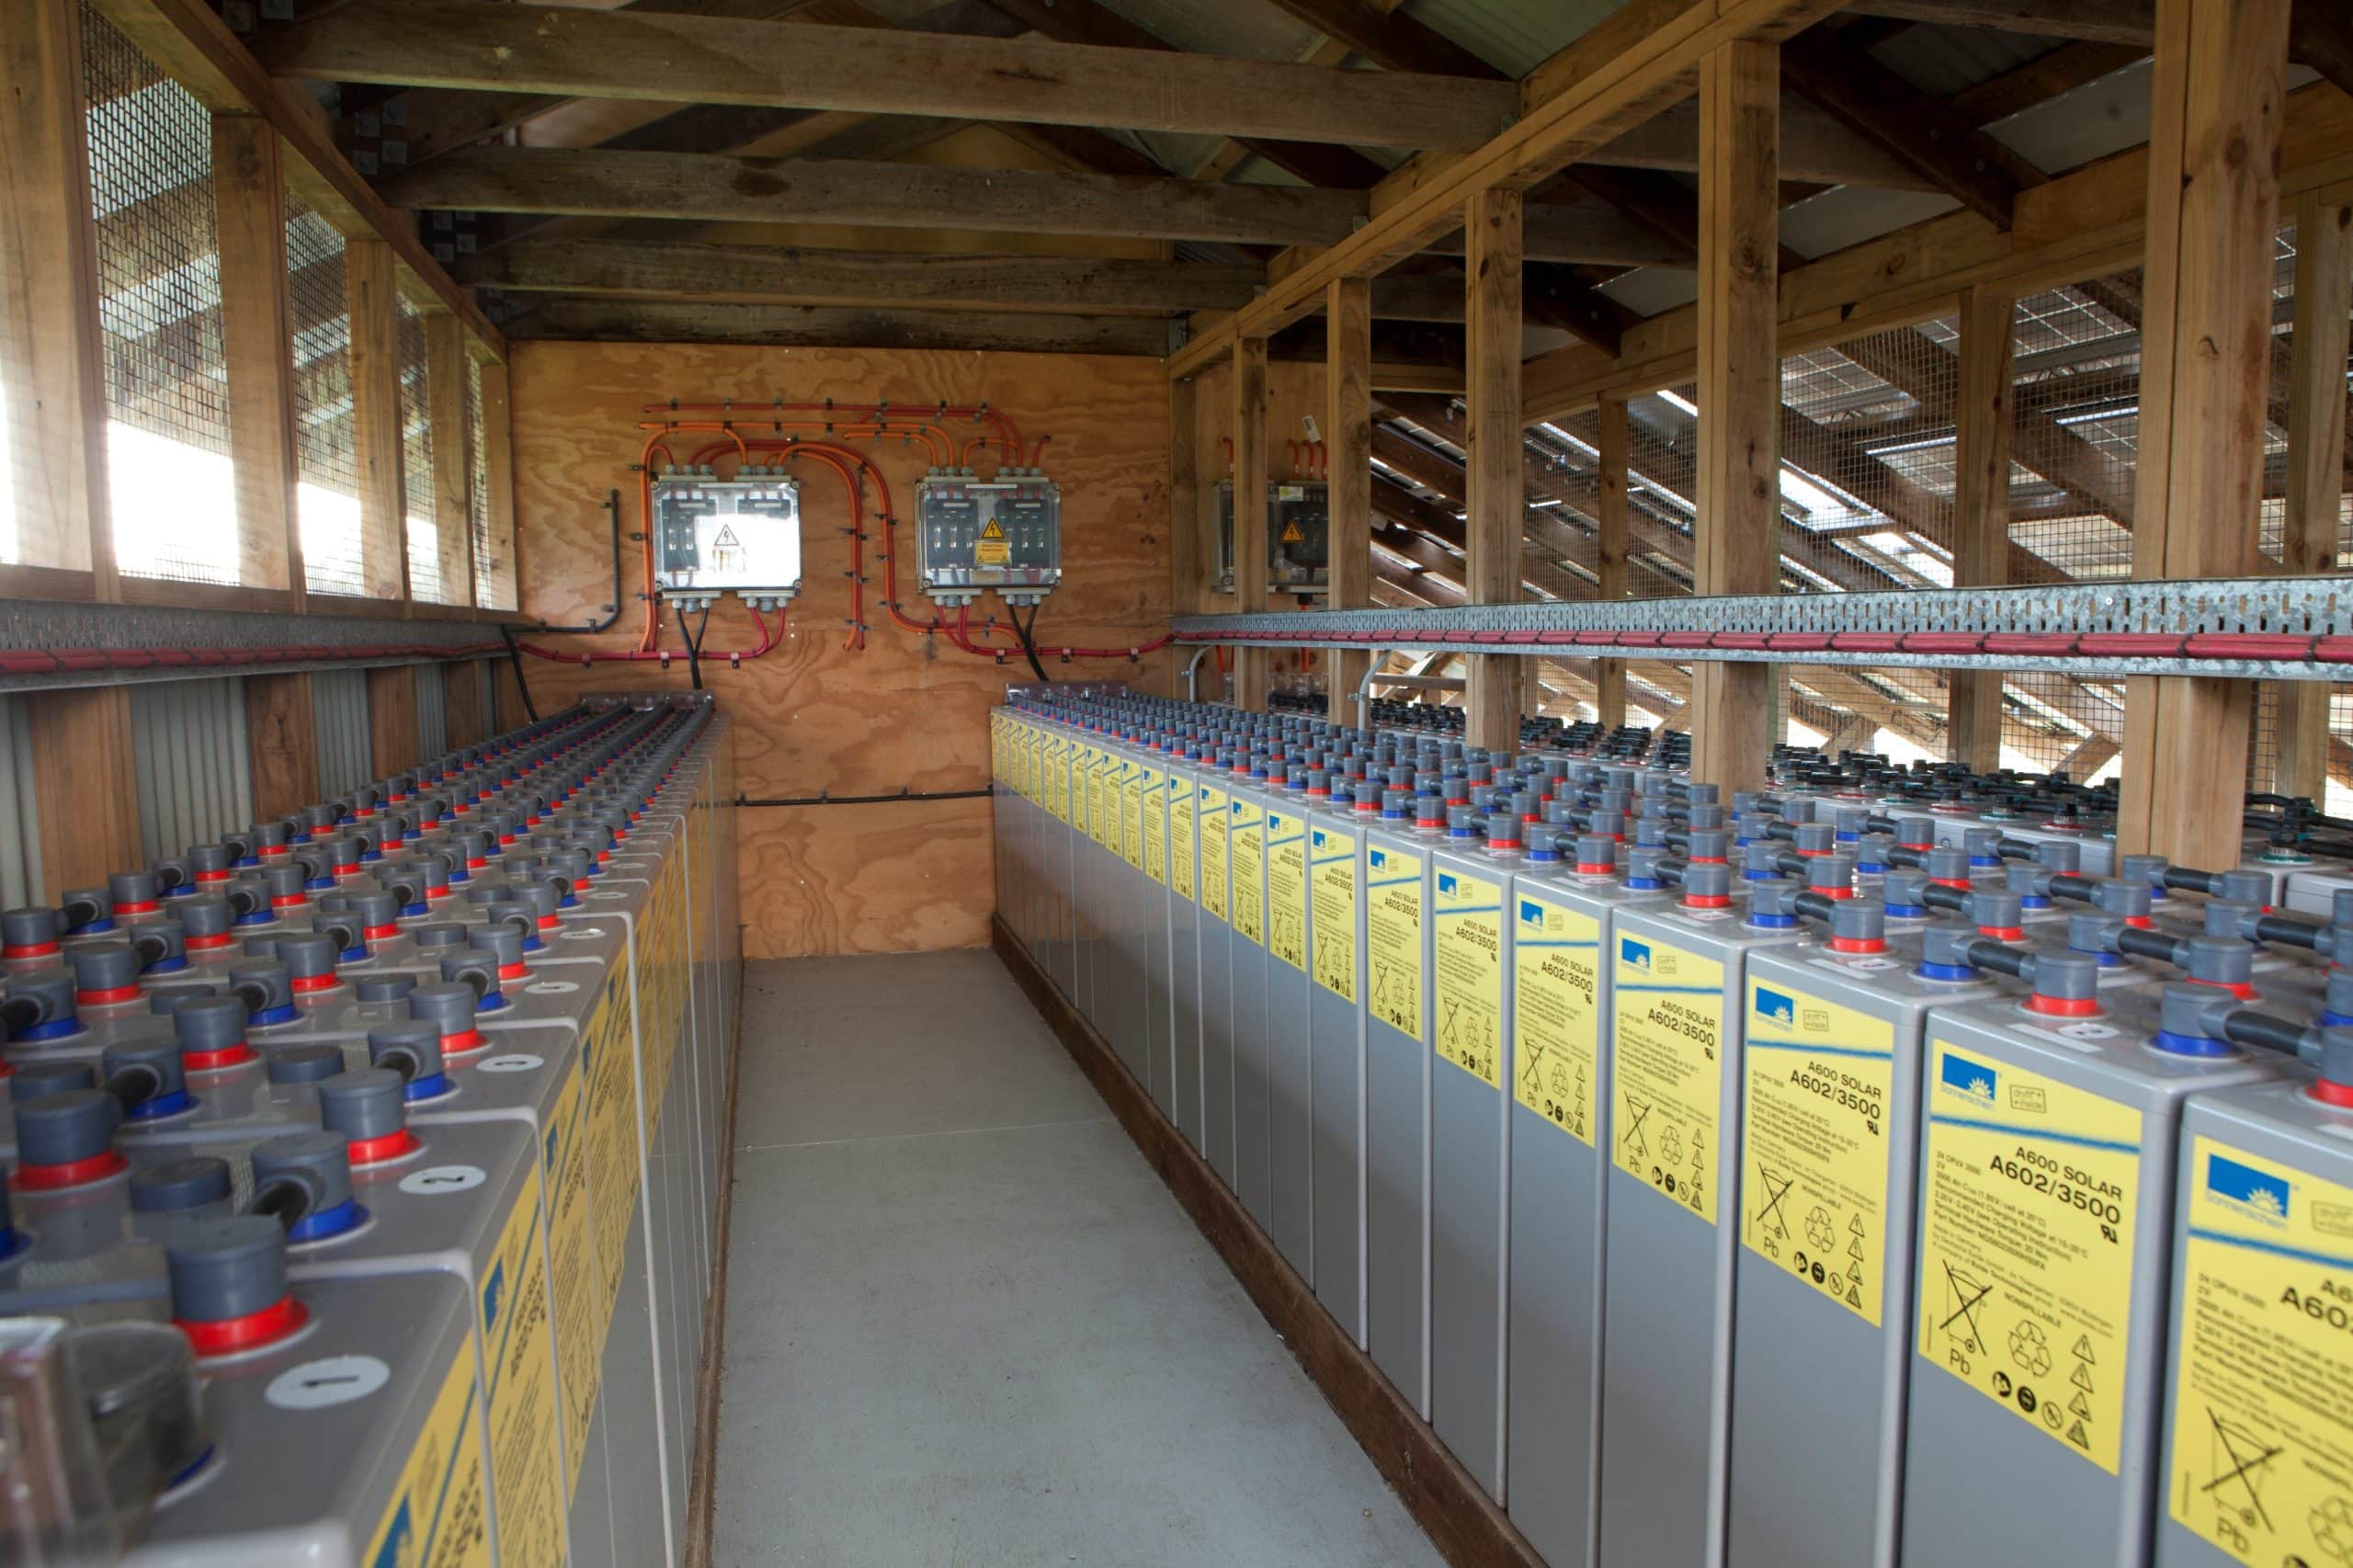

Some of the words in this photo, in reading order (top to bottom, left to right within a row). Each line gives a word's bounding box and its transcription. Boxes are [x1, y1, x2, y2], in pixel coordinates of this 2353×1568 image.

[1541, 961, 1593, 993] A602/3500
[1570, 961, 1593, 978] SOLAR
[1648, 1008, 1714, 1046] A602/3500
[1661, 1000, 1683, 1016] A600
[1686, 1009, 1715, 1029] SOLAR
[1790, 1070, 1881, 1119] A602/3500
[1809, 1061, 1837, 1081] A600
[1841, 1074, 1881, 1100] SOLAR
[1990, 1154, 2120, 1225] A602/3500
[2016, 1146, 2058, 1174] A600
[2063, 1165, 2122, 1201] SOLAR
[1764, 1236, 1779, 1258] Pb
[1949, 1347, 1971, 1376] Pb
[2217, 1516, 2250, 1554] Pb
